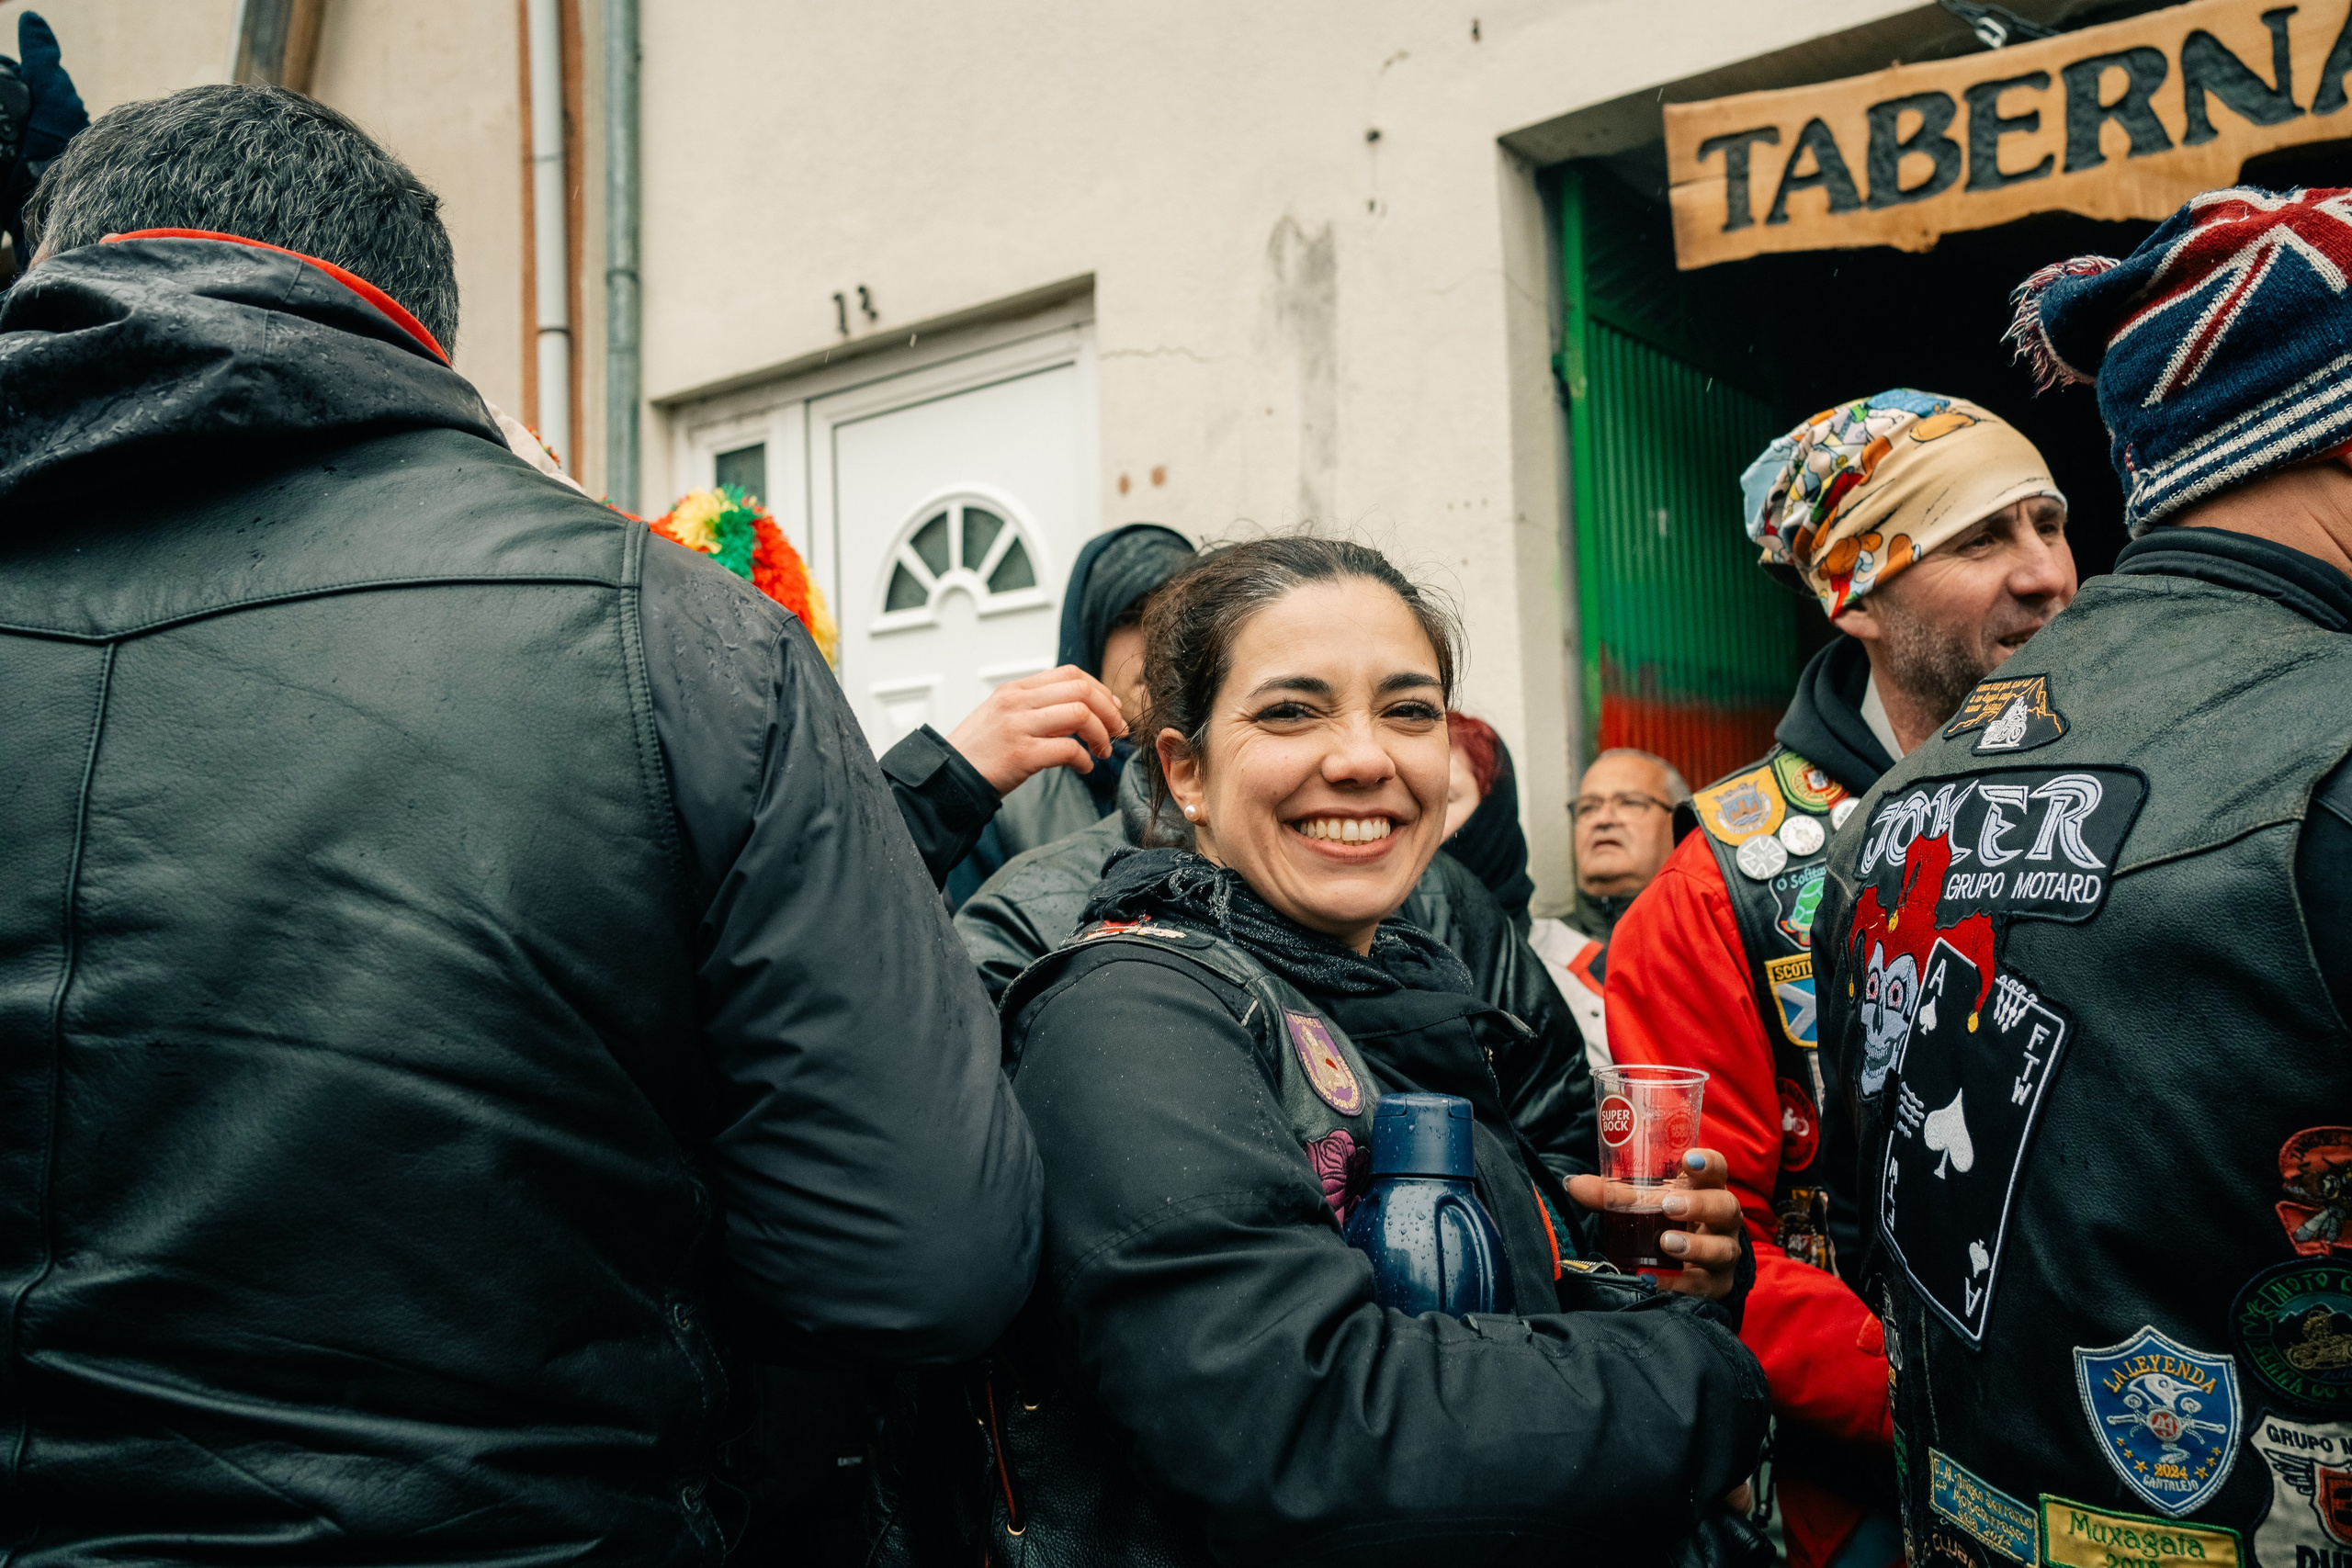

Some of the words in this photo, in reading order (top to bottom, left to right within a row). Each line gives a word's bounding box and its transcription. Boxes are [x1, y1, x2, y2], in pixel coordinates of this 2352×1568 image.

[1860, 773, 2106, 874] JOKER
[1944, 873, 2005, 901] GRUPO
[2010, 872, 2102, 903] MOTARD
[1928, 958, 1947, 998] A
[1601, 1109, 1630, 1121] SUPER
[1603, 1120, 1629, 1132] BOCK
[2102, 1368, 2129, 1393] LA
[2123, 1354, 2217, 1395] LEYENDA
[2267, 1424, 2334, 1452] GRUPO
[2143, 1473, 2199, 1492] CANTALEJO
[2154, 1462, 2188, 1481] 2024
[2068, 1510, 2206, 1559] Muxagata
